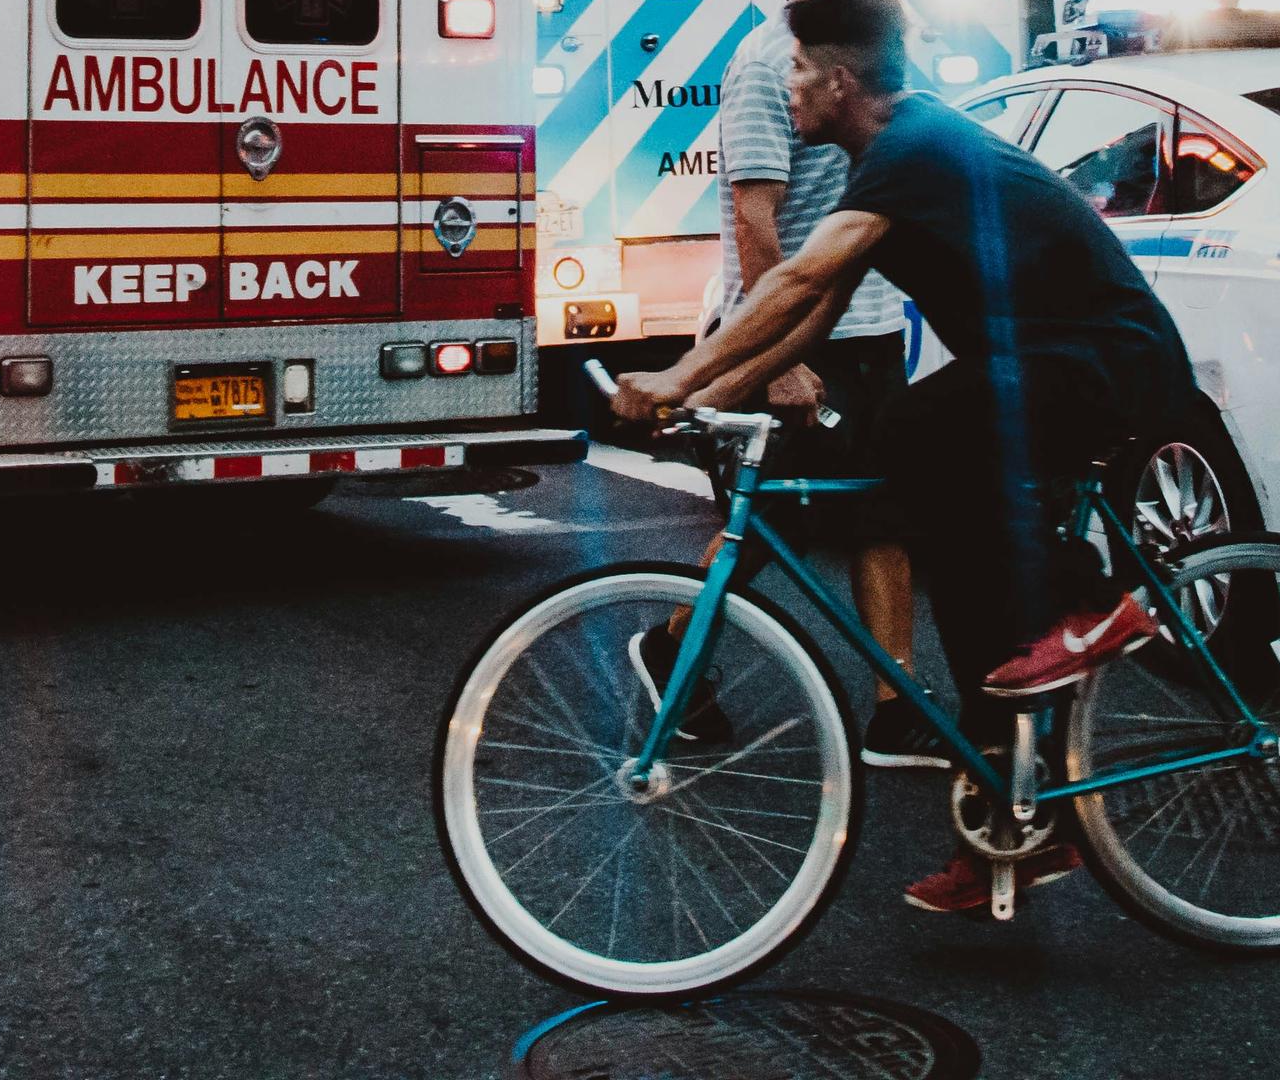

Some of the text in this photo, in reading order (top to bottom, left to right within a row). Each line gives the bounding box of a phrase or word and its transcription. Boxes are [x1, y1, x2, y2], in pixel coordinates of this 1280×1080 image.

[43, 54, 379, 115] AMBULANCE
[74, 260, 360, 305] KEEP BACK
